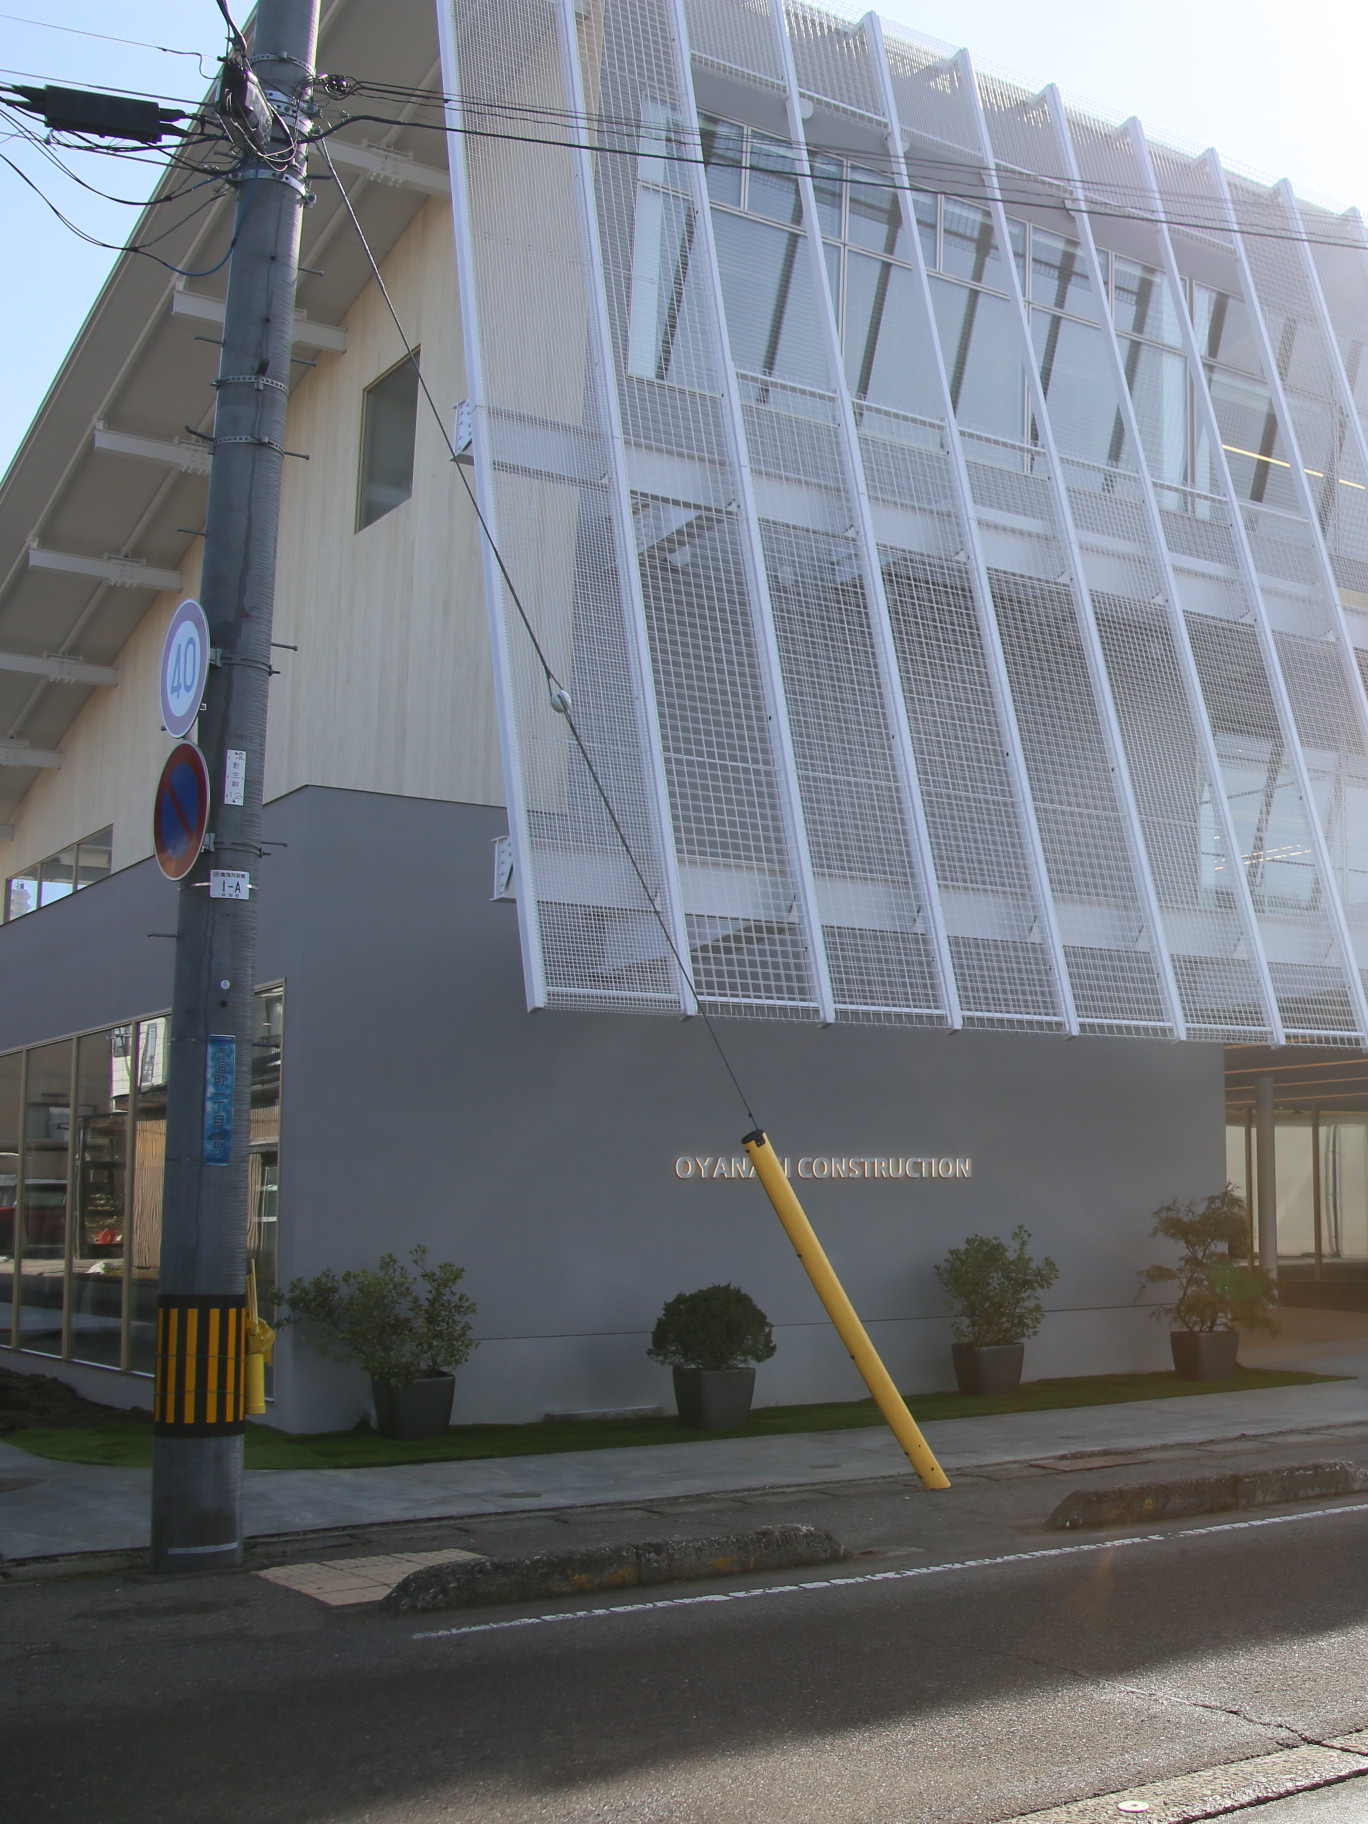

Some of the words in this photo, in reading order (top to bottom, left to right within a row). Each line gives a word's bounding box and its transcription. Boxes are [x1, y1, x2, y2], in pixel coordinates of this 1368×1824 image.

[170, 636, 197, 700] 40
[212, 1140, 225, 1157] 5
[674, 1156, 792, 1179] OYANI
[797, 1156, 973, 1179] CONSTRUCTION
